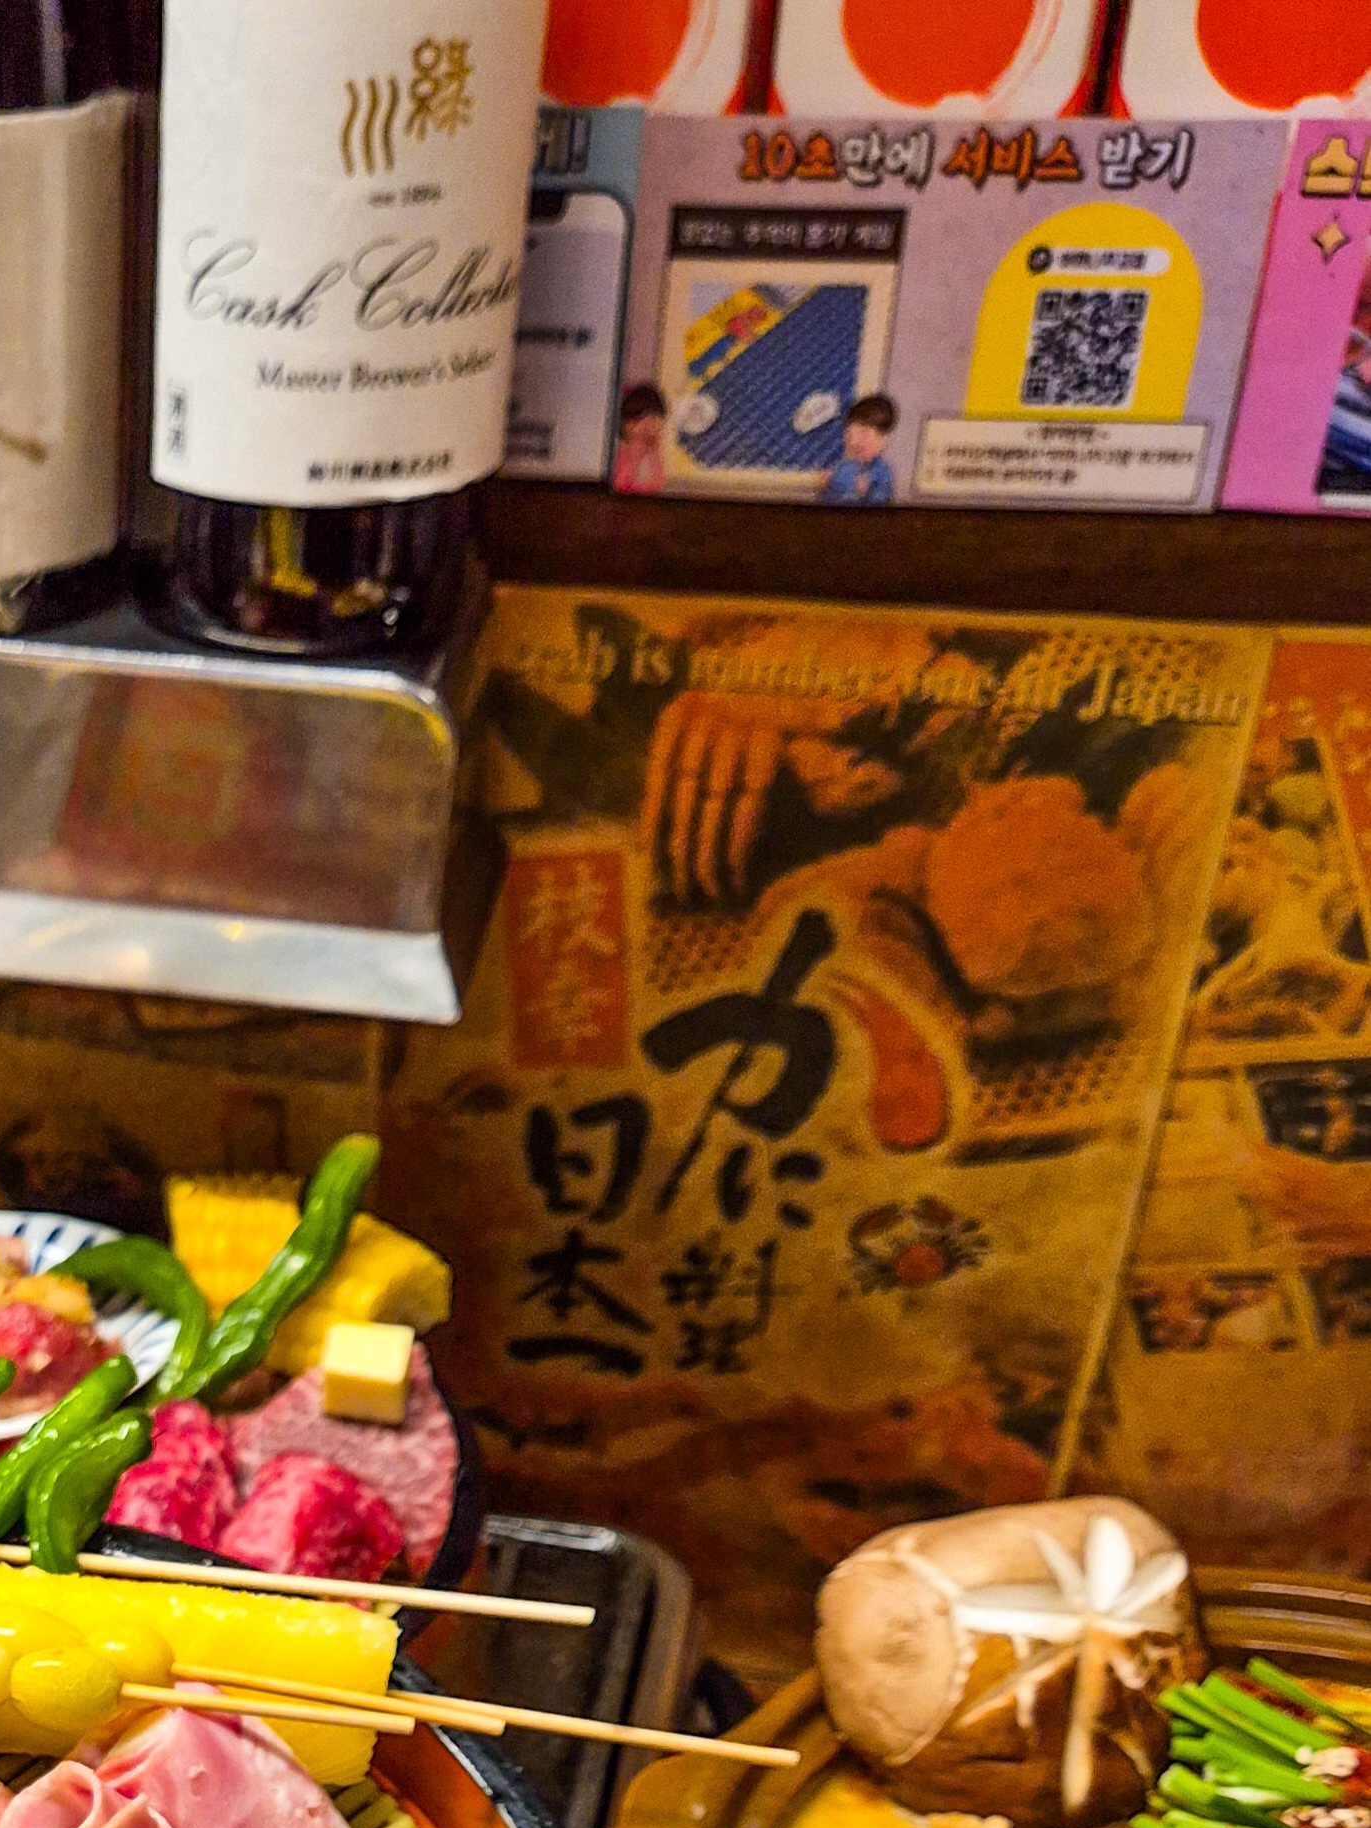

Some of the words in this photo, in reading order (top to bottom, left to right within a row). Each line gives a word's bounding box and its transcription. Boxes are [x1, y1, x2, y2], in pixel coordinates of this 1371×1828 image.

[737, 122, 935, 193] 10초만에
[941, 127, 1085, 193] 서비스
[1098, 126, 1195, 190] 받기
[181, 228, 348, 331] Cask
